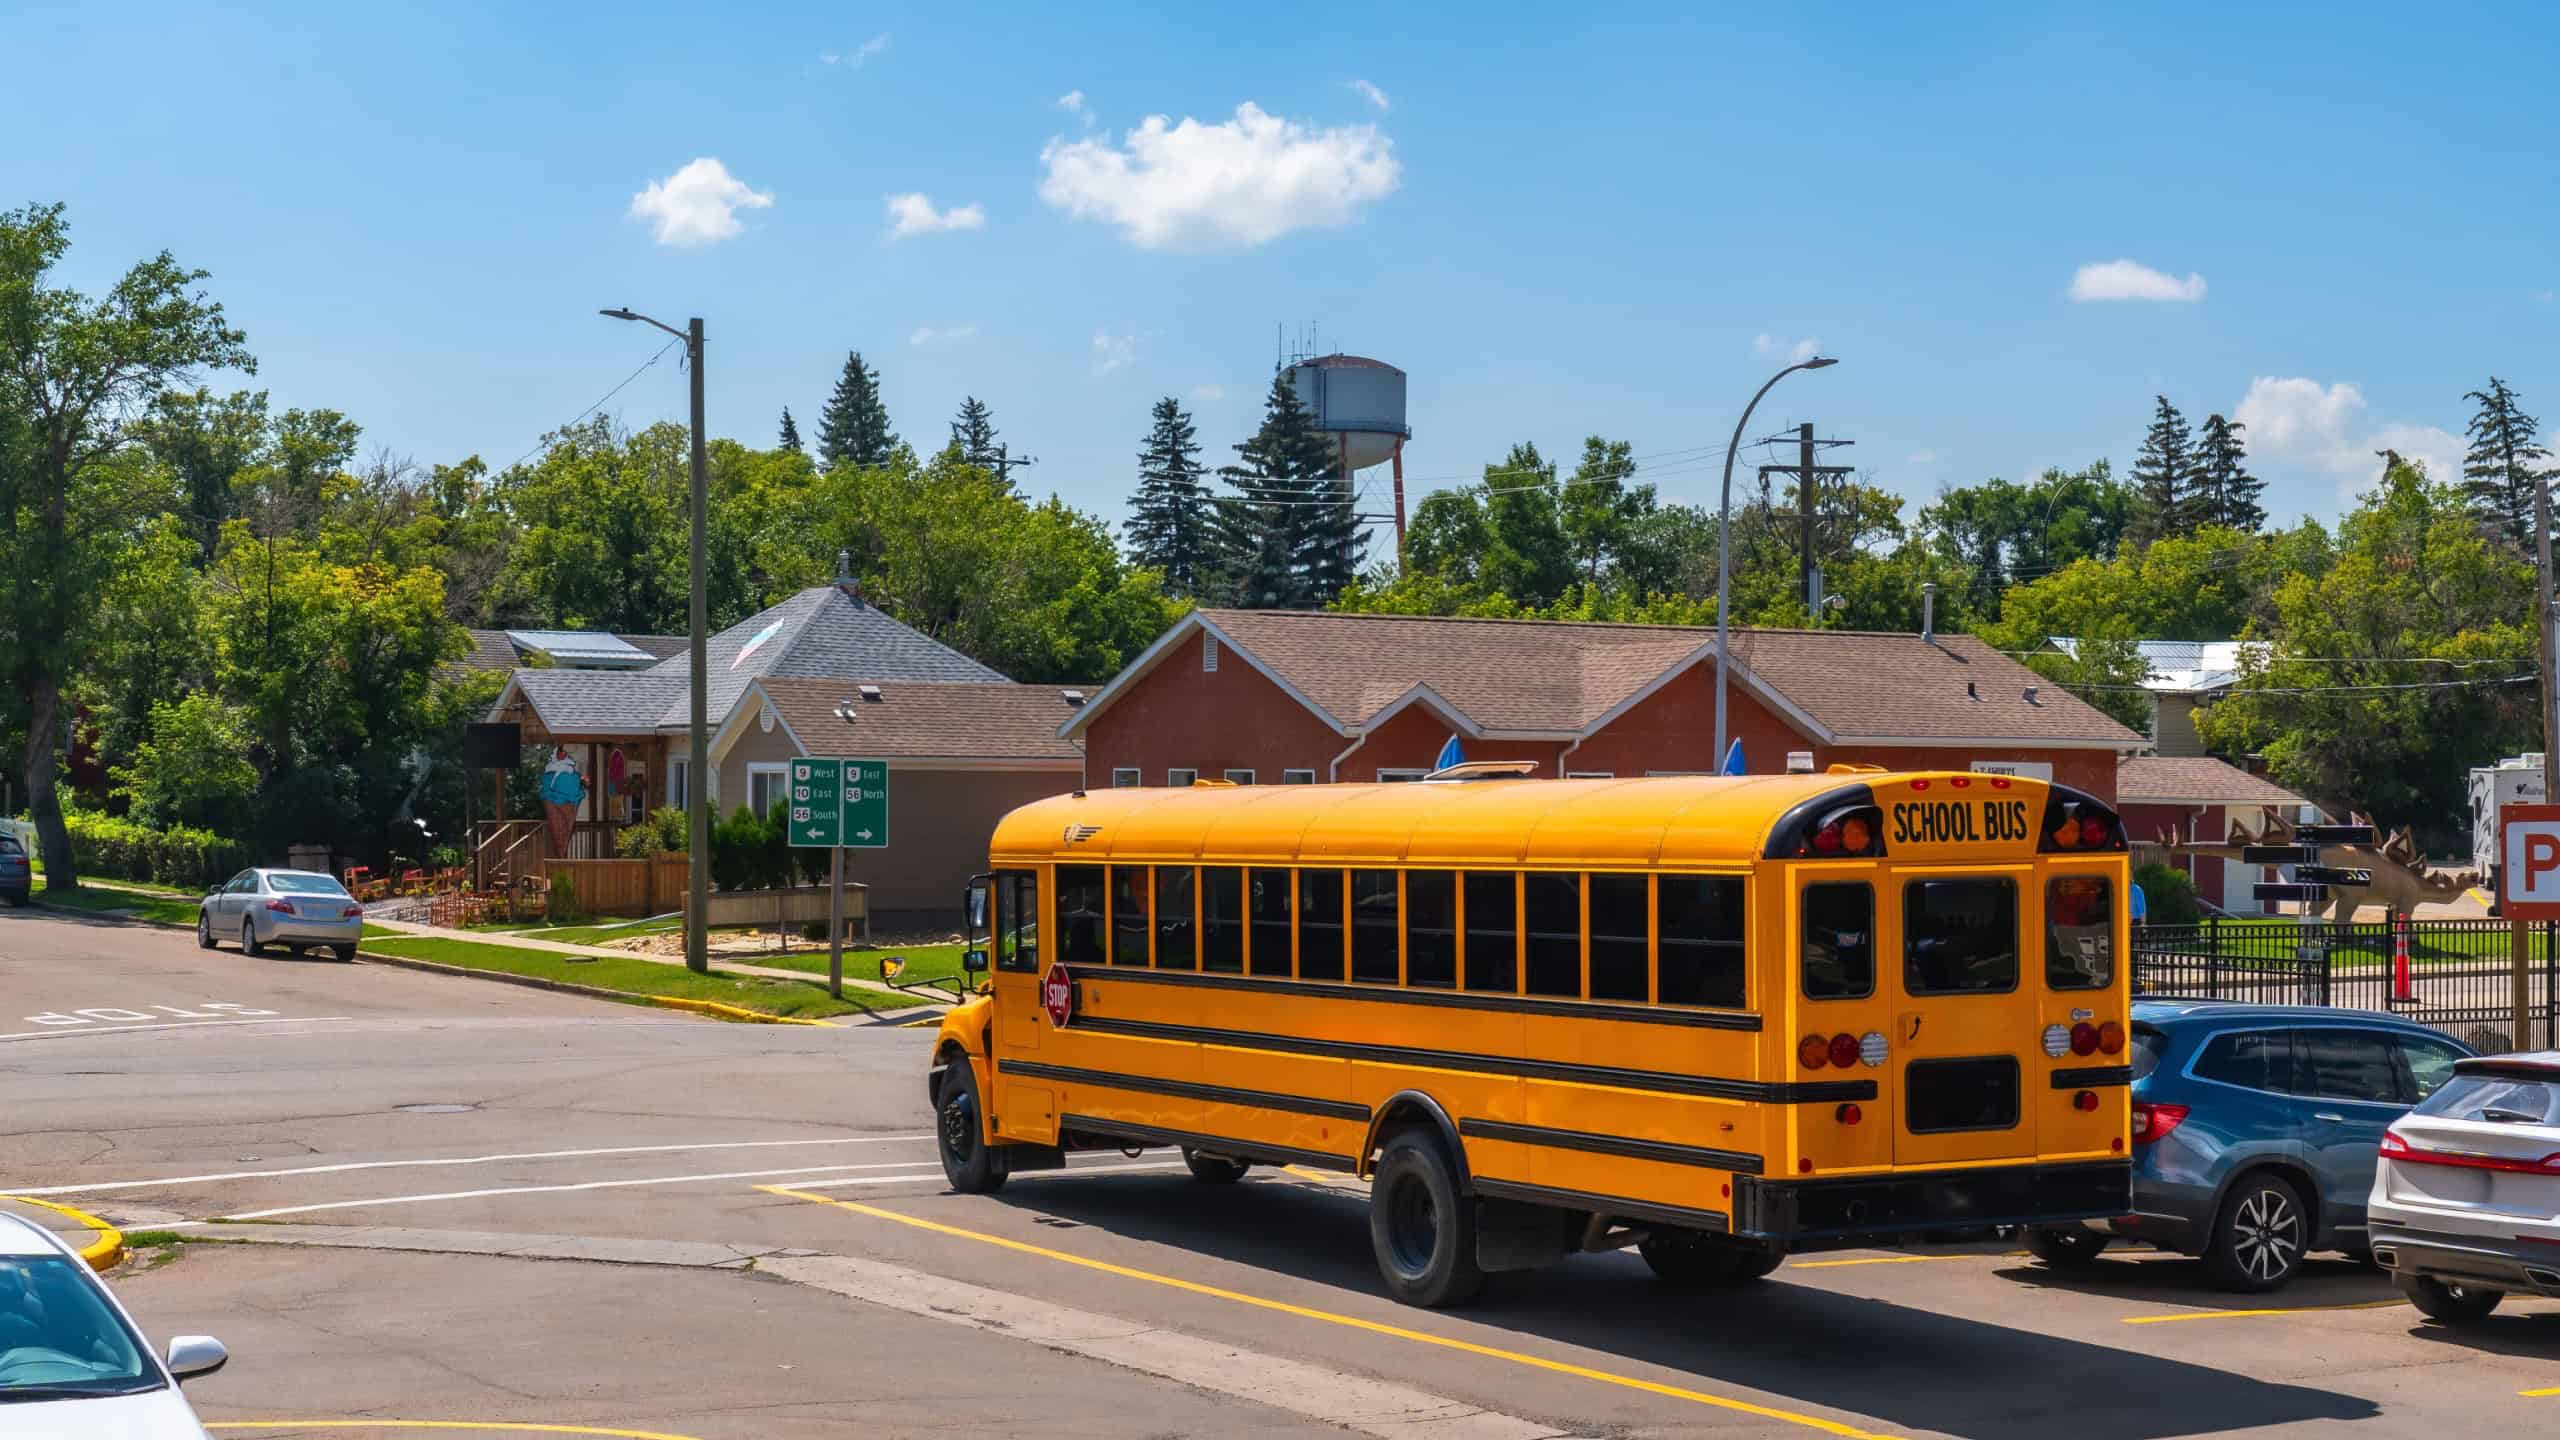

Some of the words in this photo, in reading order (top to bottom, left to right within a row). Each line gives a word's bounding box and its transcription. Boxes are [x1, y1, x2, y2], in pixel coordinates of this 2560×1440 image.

[799, 768, 807, 778] 9
[813, 768, 835, 778] West
[850, 769, 858, 779] 9
[864, 770, 881, 779] East
[796, 788, 809, 798] 10
[813, 789, 832, 798] East
[847, 790, 860, 800] 56
[864, 790, 884, 800] North
[795, 809, 809, 819] 56
[813, 809, 837, 819] South
[1893, 801, 1980, 843] SCHOOL
[1984, 801, 2027, 841] BUS
[2525, 833, 2560, 892] P
[1048, 983, 1068, 1008] STOP
